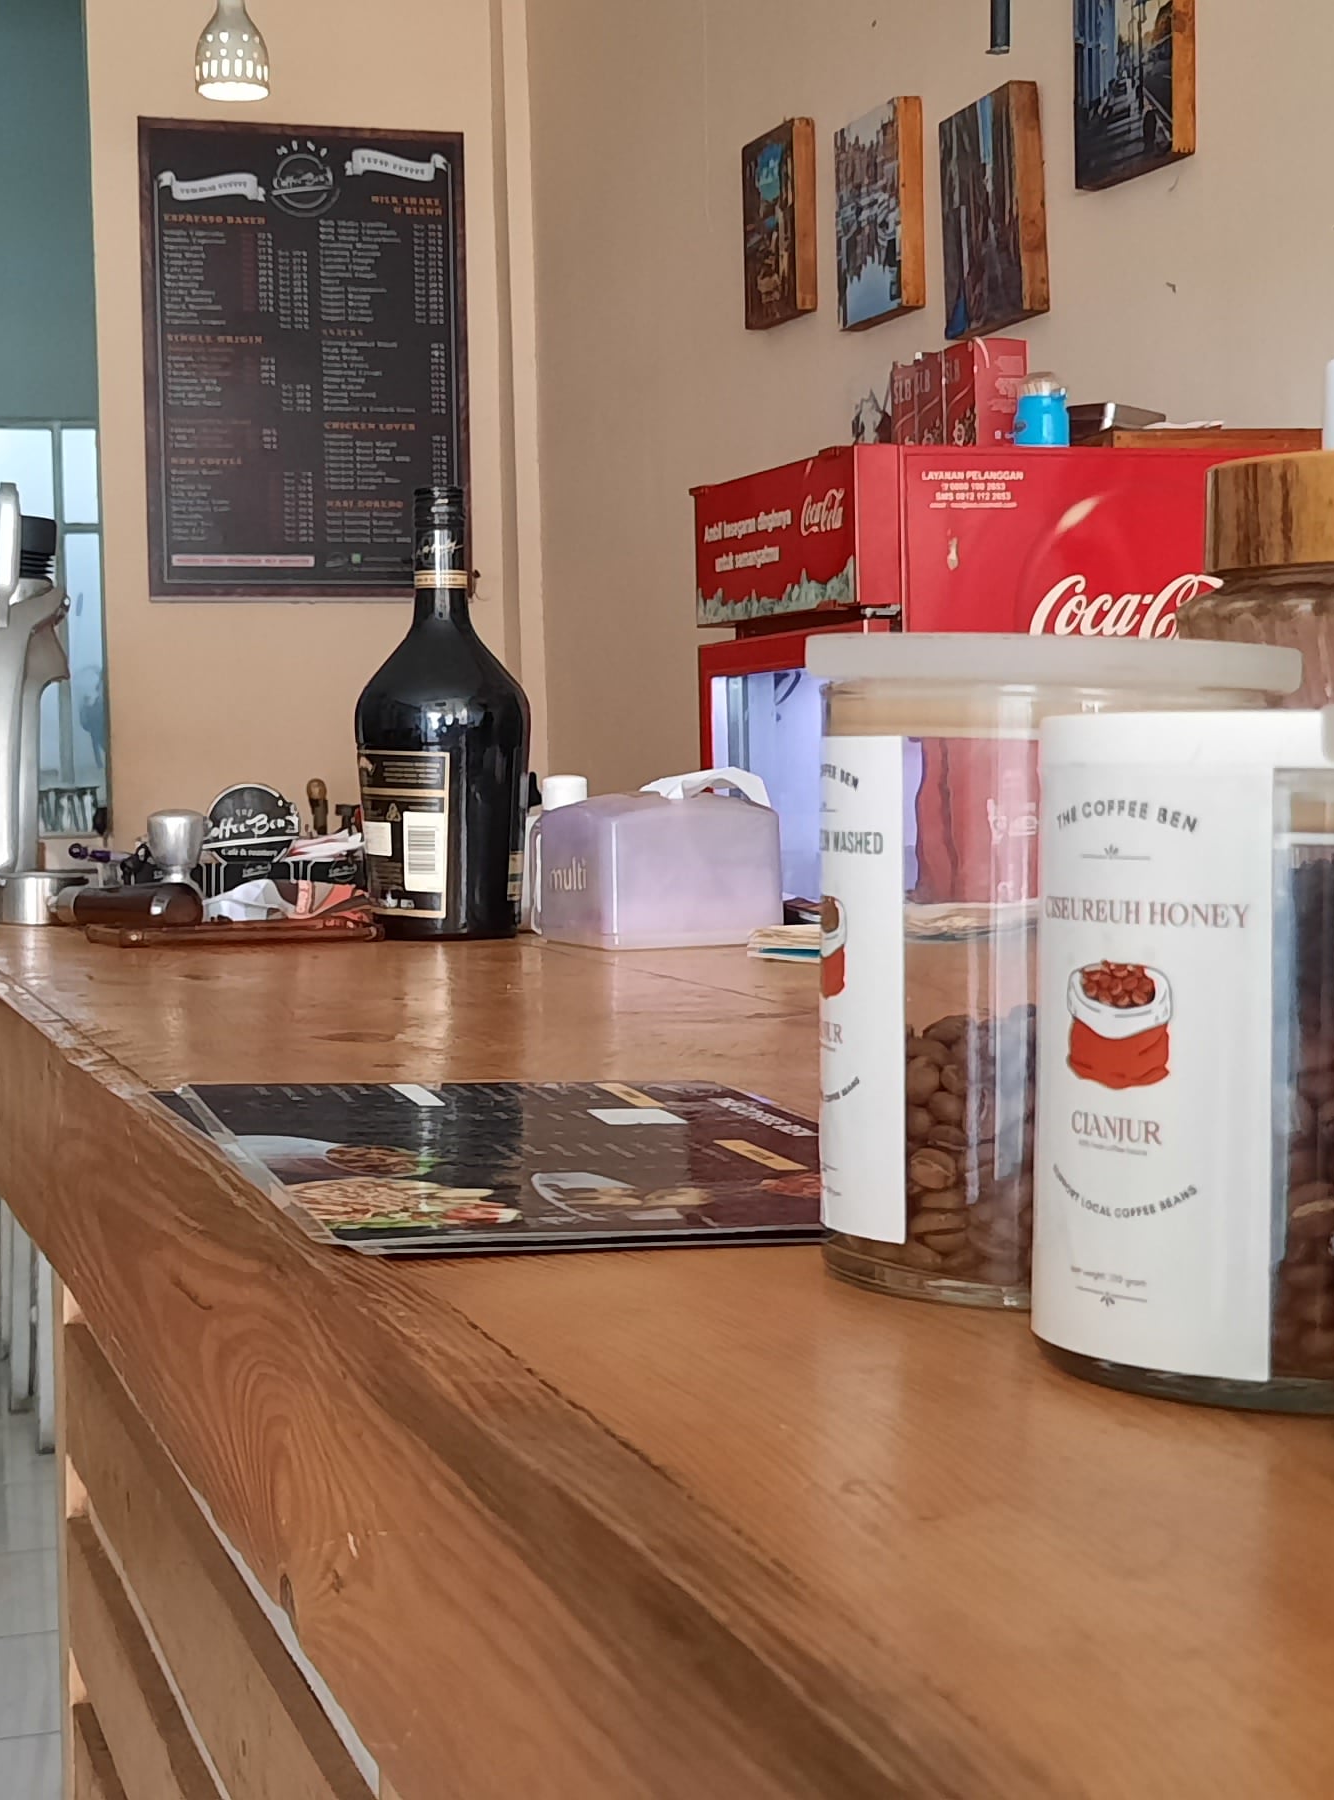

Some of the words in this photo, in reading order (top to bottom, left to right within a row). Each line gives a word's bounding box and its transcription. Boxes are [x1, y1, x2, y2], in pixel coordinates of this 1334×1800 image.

[921, 470, 965, 480] LAYANAN
[966, 470, 1024, 480] PELANGGAN
[1029, 573, 1224, 641] Coca-C
[1056, 805, 1078, 831] THE
[1081, 799, 1149, 821] COFFEE
[1156, 806, 1199, 834] BEN
[833, 830, 884, 855] WASHED
[550, 856, 587, 890] multi
[1147, 900, 1251, 929] HONEY
[1071, 1109, 1163, 1146] CIANJUR
[1080, 1196, 1112, 1218] LOCAL
[1114, 1204, 1157, 1219] COFFEE
[1159, 1184, 1198, 1212] BEANS
